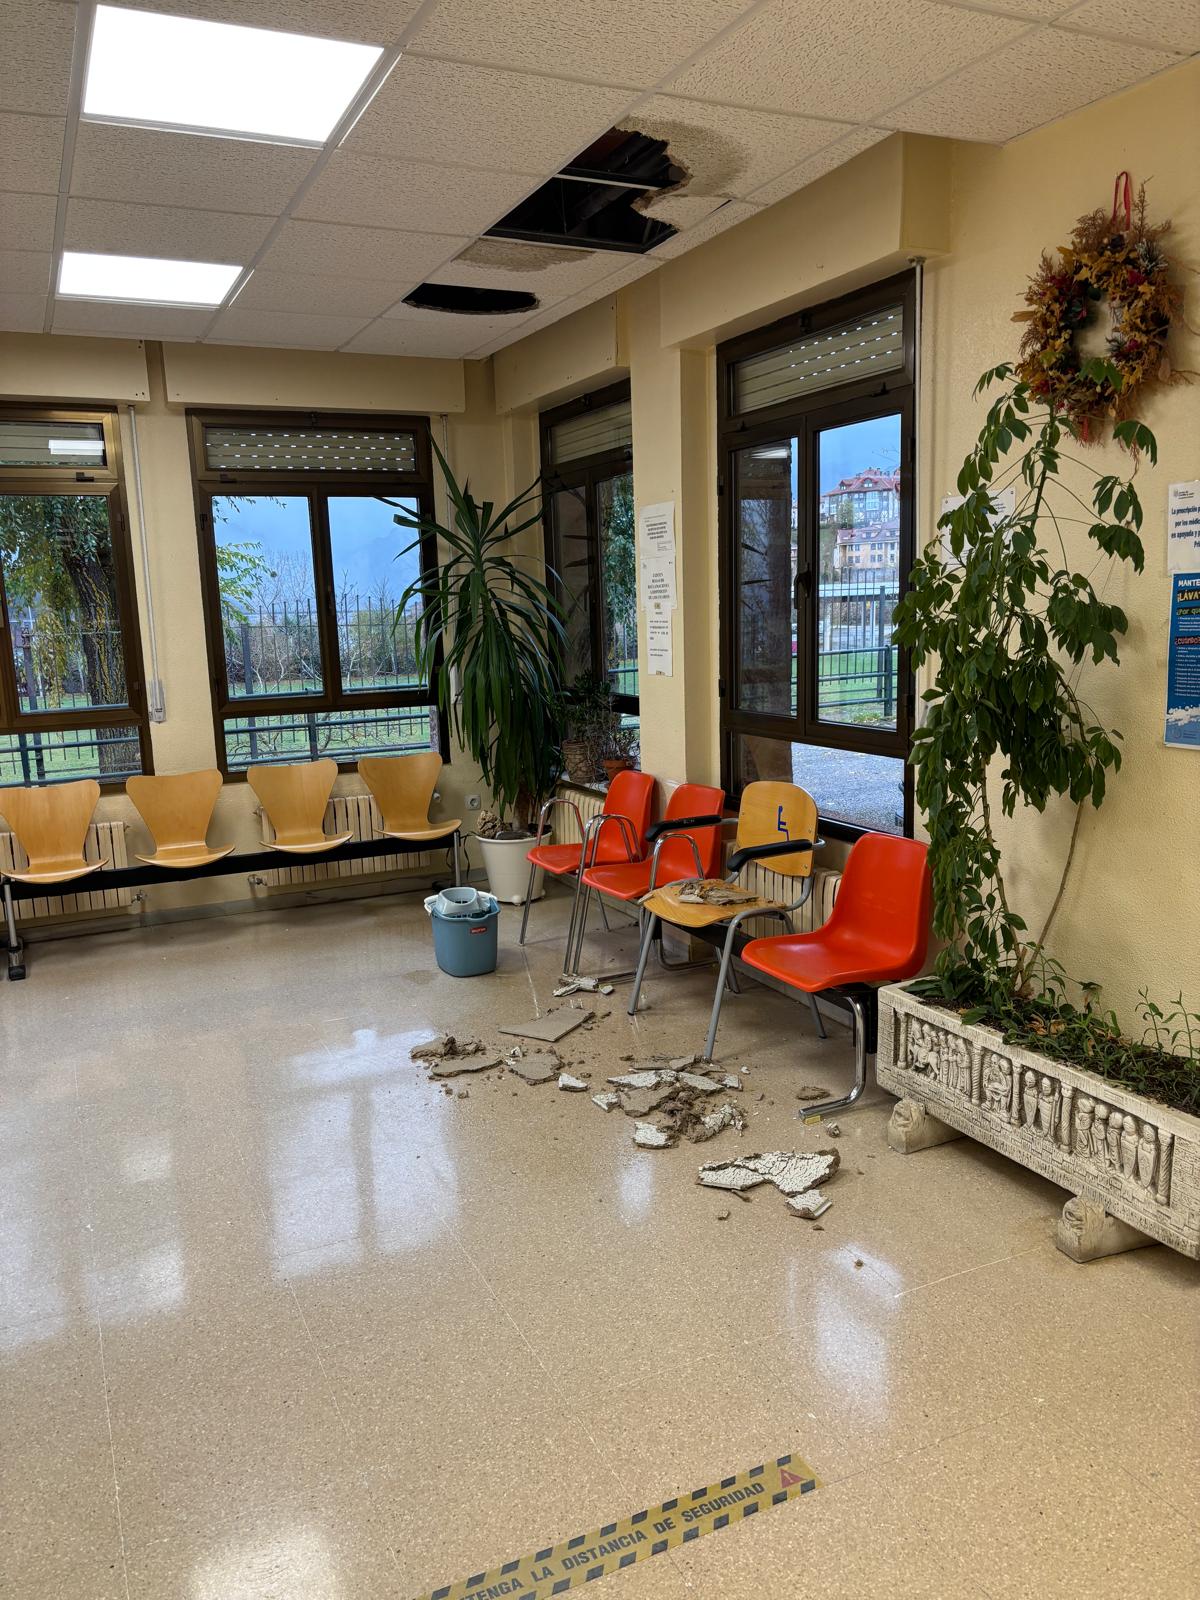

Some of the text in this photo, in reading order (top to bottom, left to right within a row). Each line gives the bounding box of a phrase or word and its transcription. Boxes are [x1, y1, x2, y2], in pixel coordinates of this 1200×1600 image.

[458, 1482, 766, 1600] TENGA LA DISTANCIA DE SEGURIDAD
